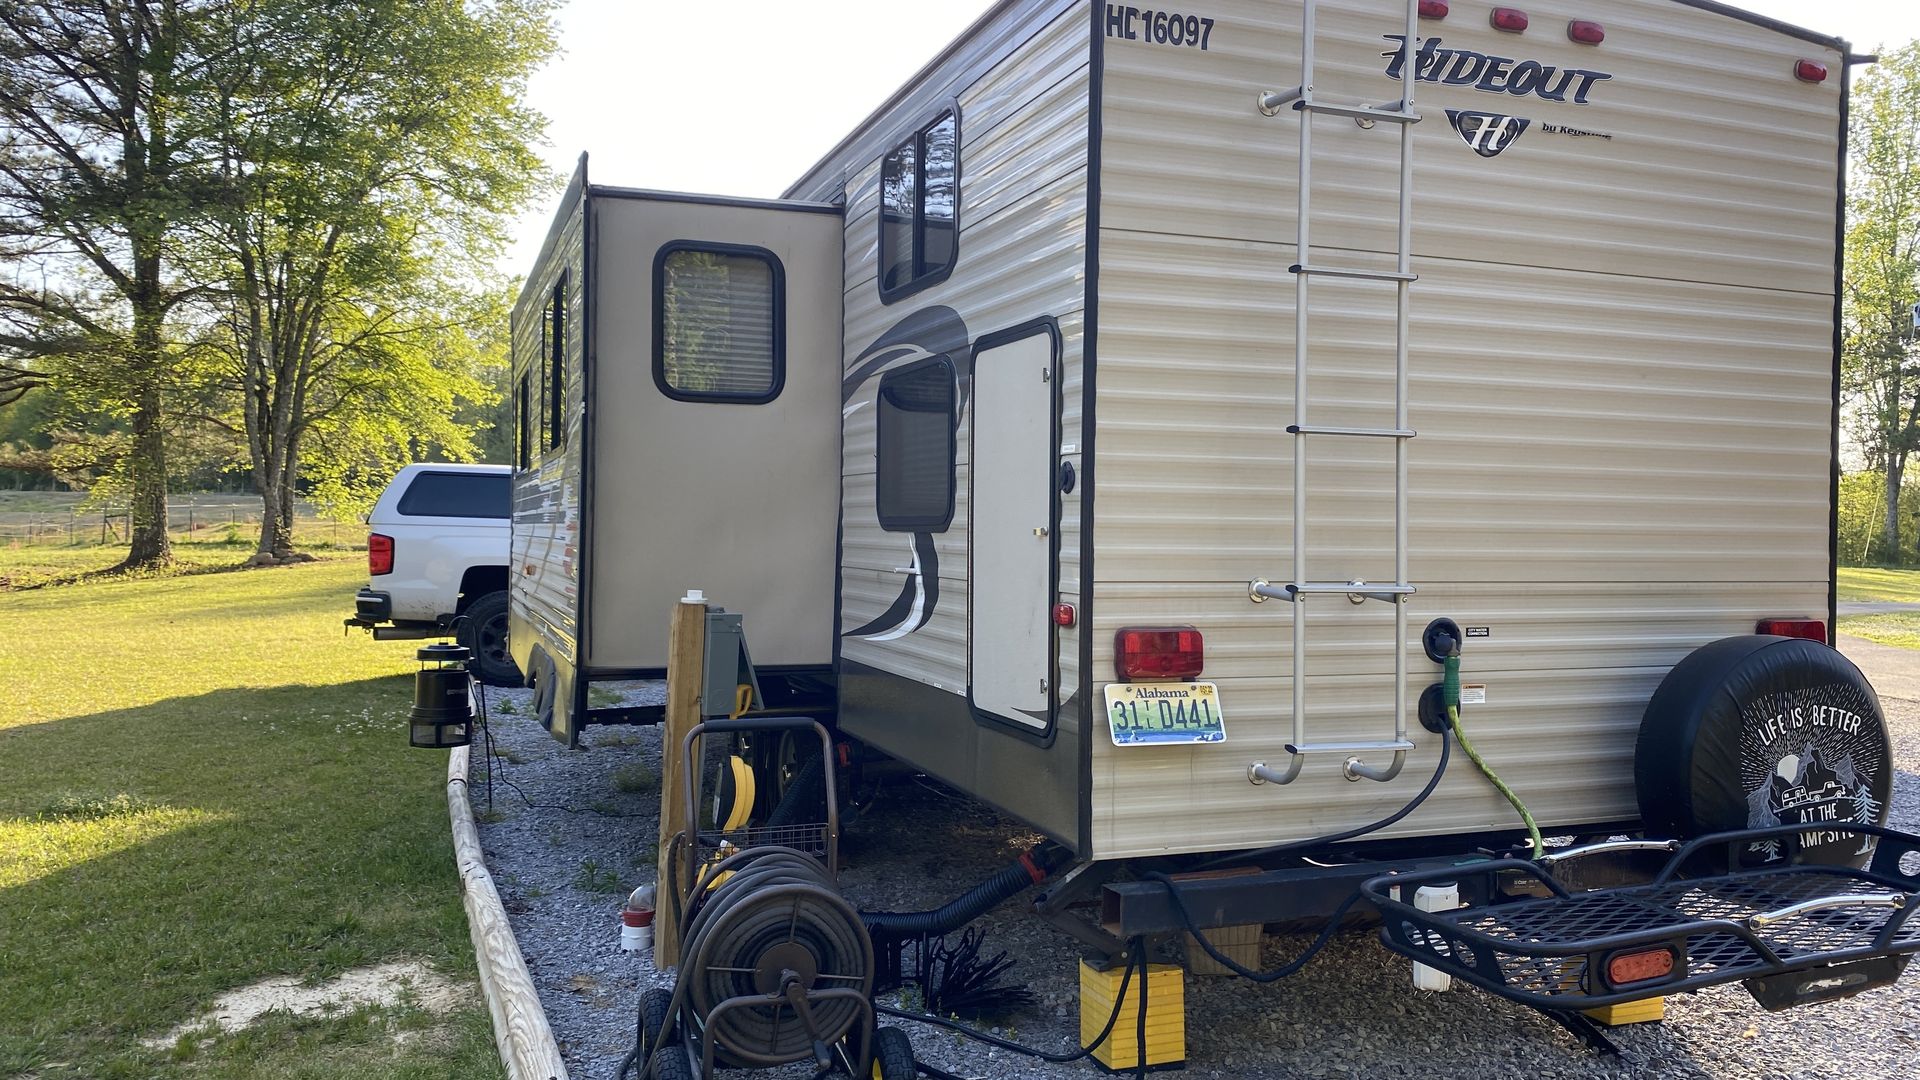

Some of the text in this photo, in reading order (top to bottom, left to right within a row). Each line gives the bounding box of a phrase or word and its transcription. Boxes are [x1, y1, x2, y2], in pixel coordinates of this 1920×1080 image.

[1380, 34, 1613, 104] HIDEOUT
[1135, 687, 1190, 699] Alabama
[1114, 700, 1143, 730] 31
[1158, 699, 1217, 729] D441
[1757, 704, 1862, 746] LIFE IS BETTER
[1800, 802, 1838, 824] AT THE
[1799, 817, 1855, 848] AMPSITE
